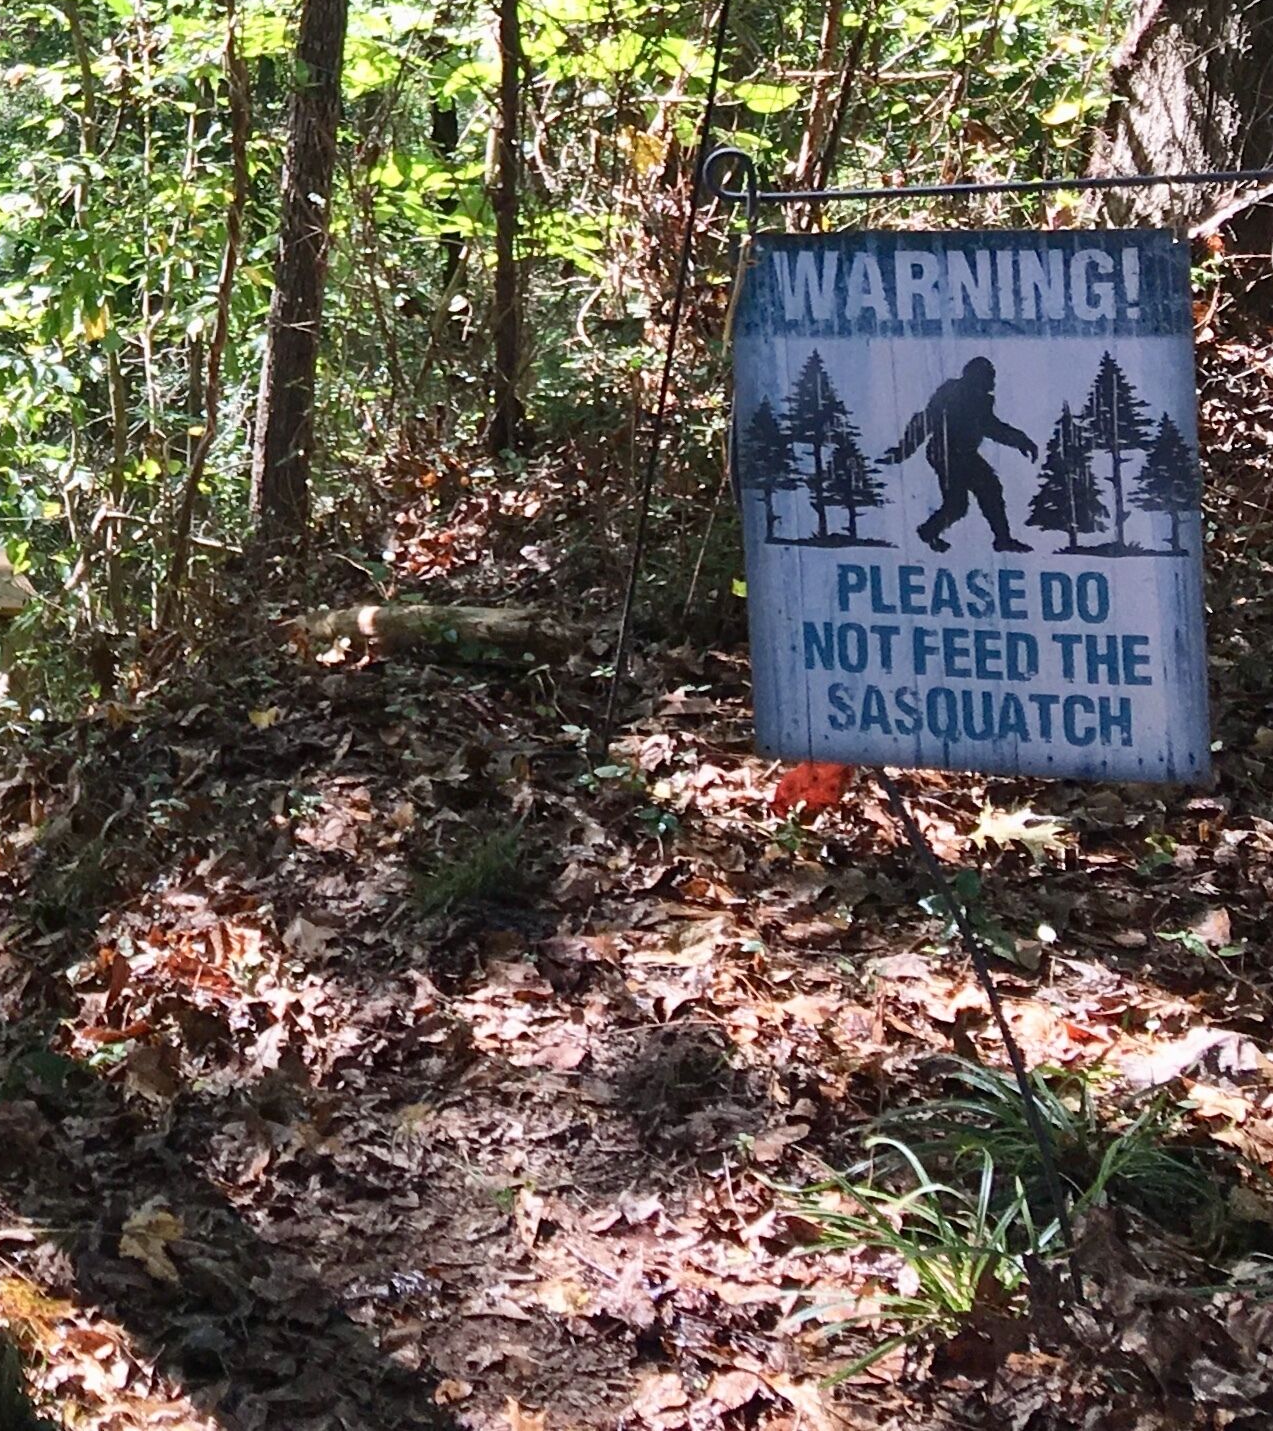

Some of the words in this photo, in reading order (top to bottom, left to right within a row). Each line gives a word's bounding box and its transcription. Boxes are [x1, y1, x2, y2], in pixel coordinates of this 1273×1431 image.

[773, 247, 1139, 321] WARNING!
[837, 564, 1027, 619] PLEASE
[1040, 572, 1109, 623] DO
[803, 622, 900, 673] NOT
[913, 627, 1039, 681] FEED
[1052, 634, 1152, 685] THE
[828, 682, 1132, 747] SASQUATCH
